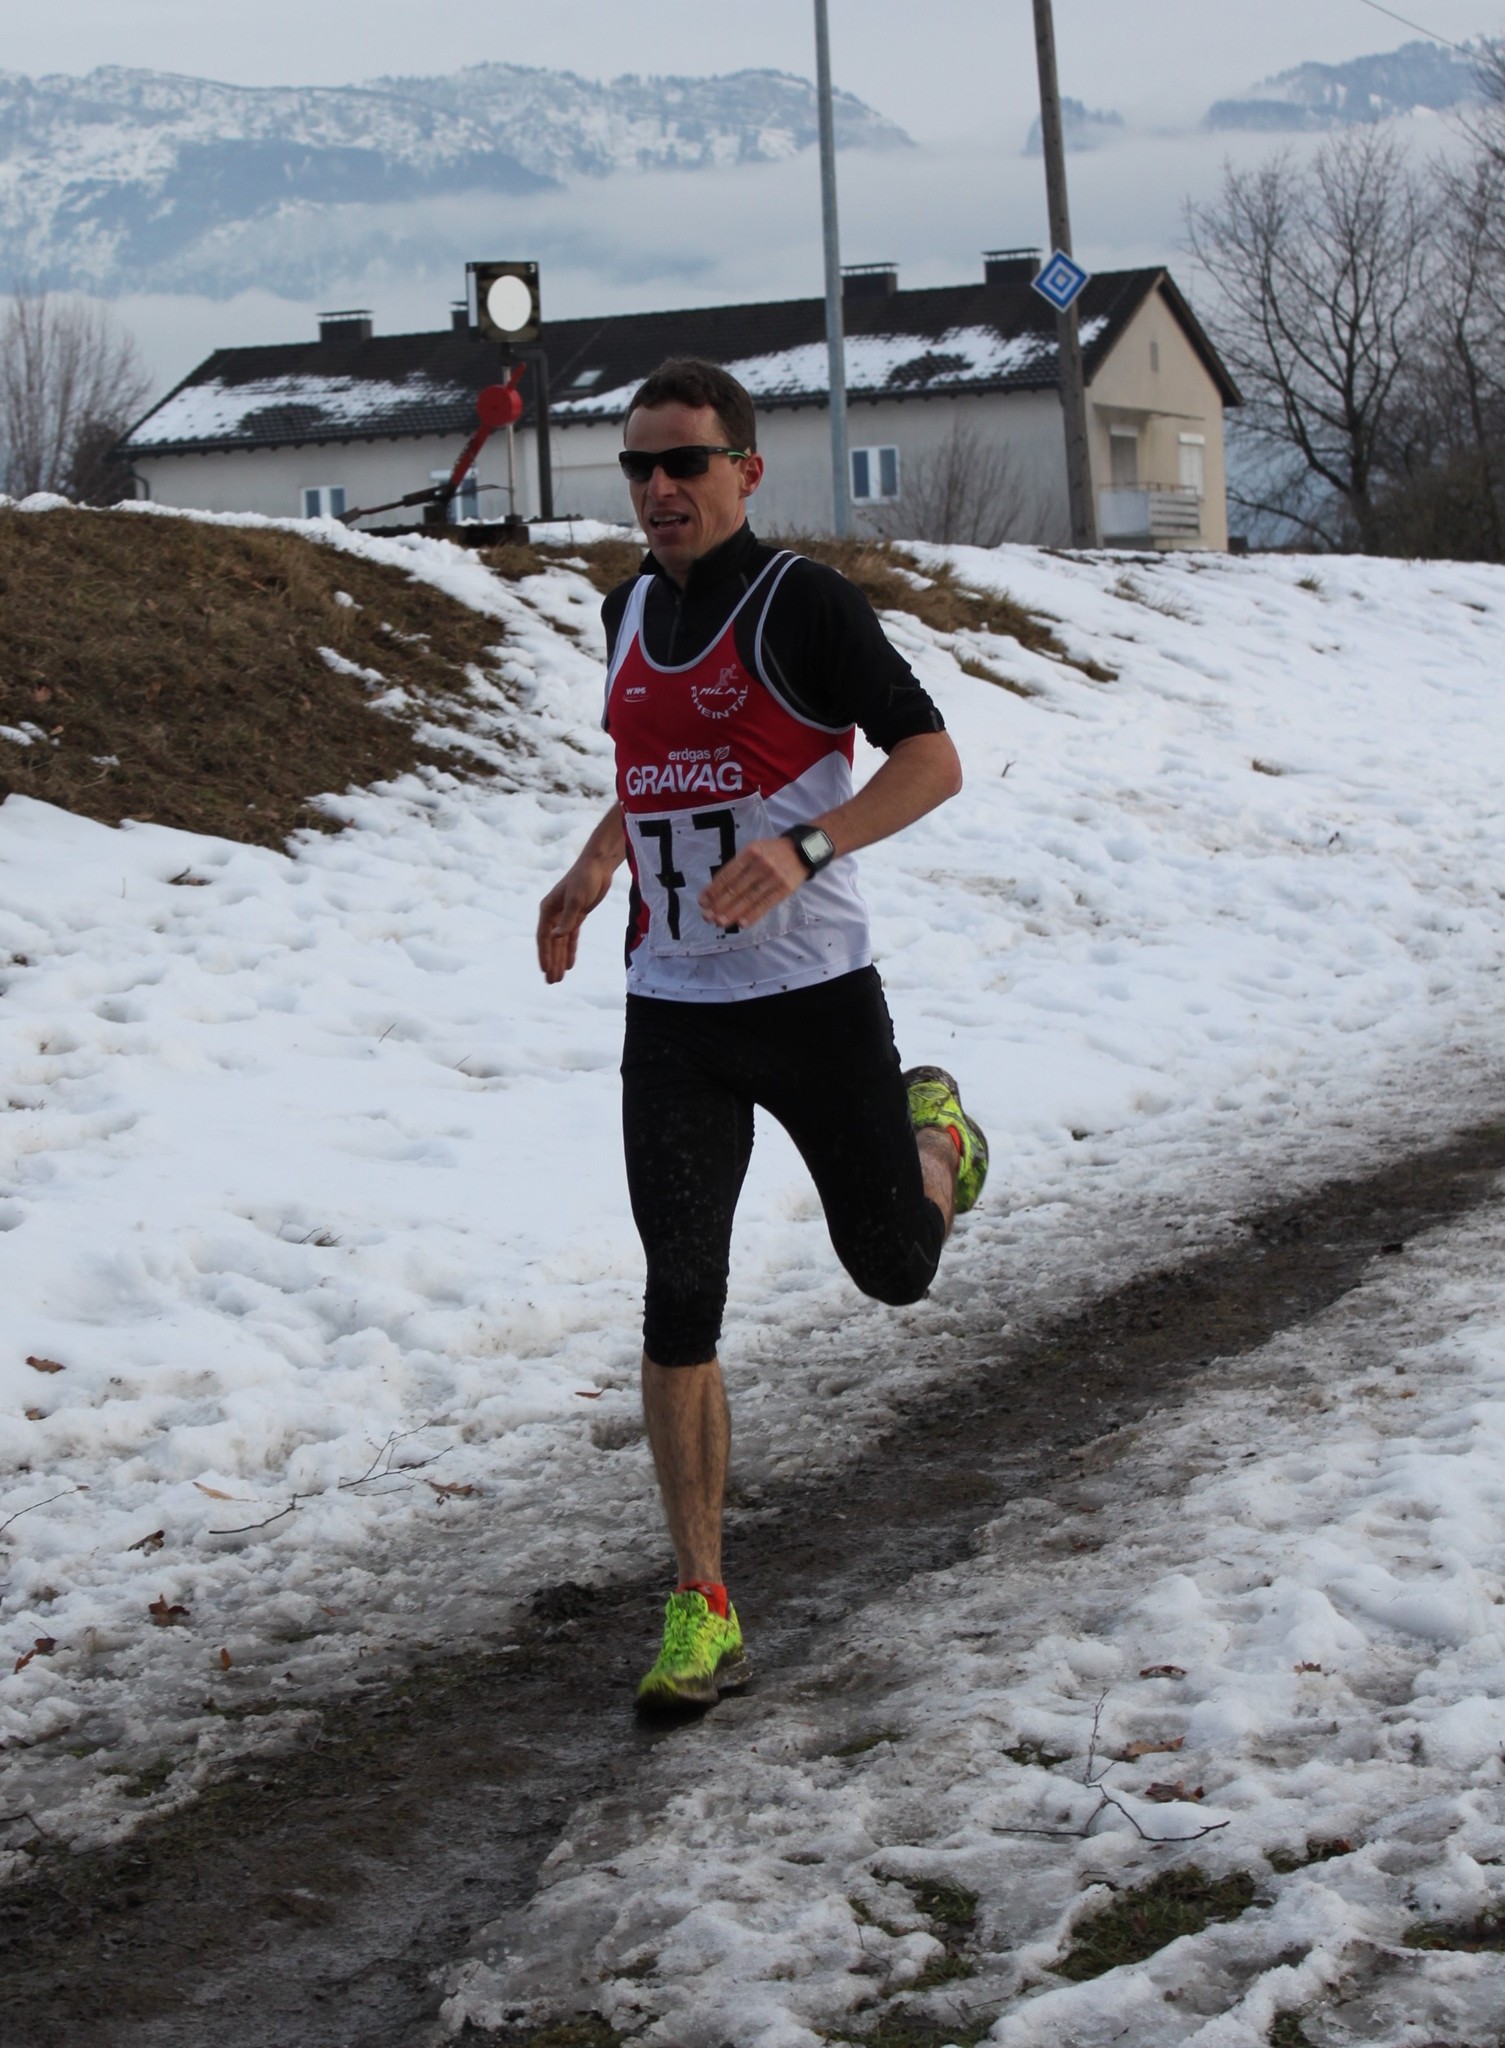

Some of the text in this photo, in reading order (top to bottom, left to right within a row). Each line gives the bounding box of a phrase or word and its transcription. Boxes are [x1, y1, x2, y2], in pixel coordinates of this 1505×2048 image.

[691, 685, 749, 719] RHEINTAL
[699, 687, 738, 695] MILA
[668, 748, 711, 763] erdgas
[625, 761, 743, 796] GRAVAG
[638, 808, 740, 941] 77
